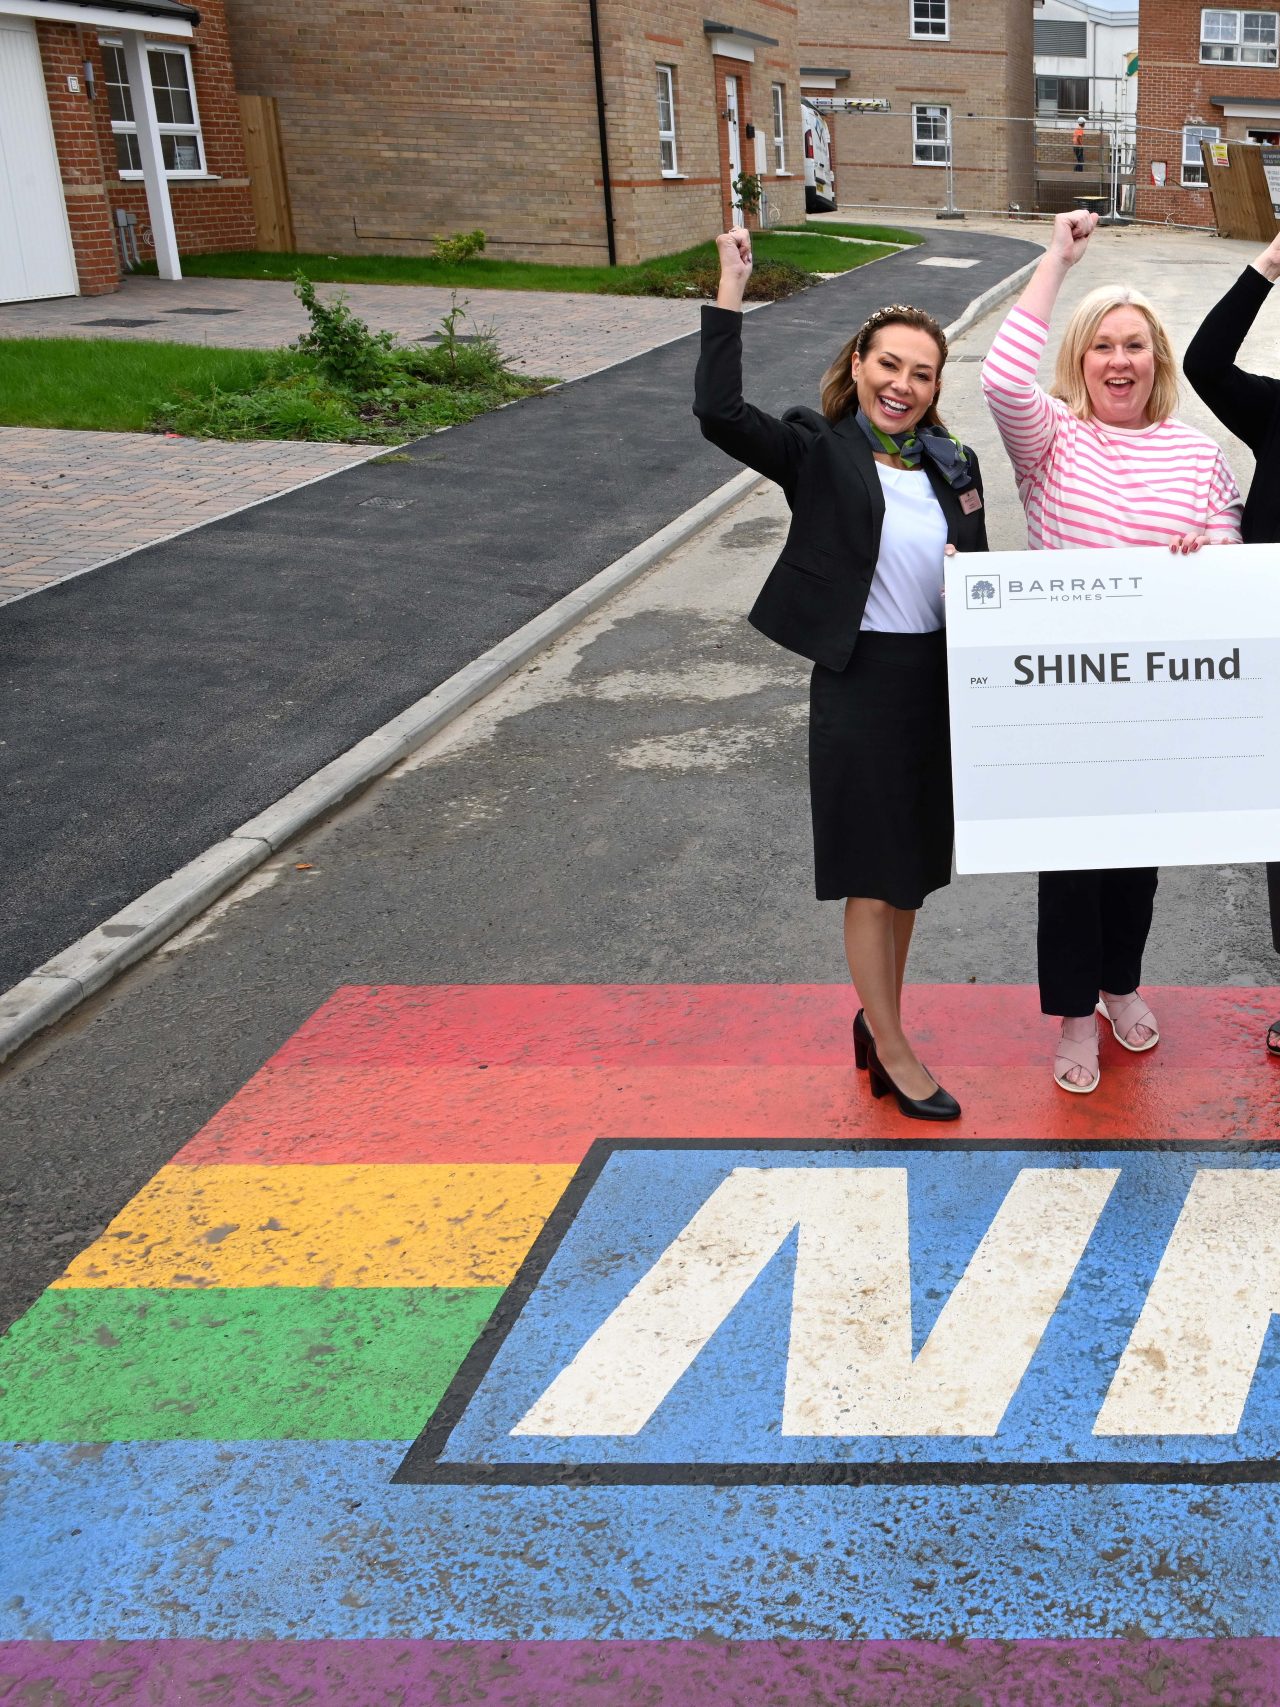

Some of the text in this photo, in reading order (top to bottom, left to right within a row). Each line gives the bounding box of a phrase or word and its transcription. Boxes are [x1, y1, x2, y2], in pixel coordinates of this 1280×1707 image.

[1008, 577, 1142, 592] BARRATT
[1050, 594, 1102, 602] HOMES
[1014, 652, 1131, 685] SHINE
[1146, 648, 1240, 681] Fund
